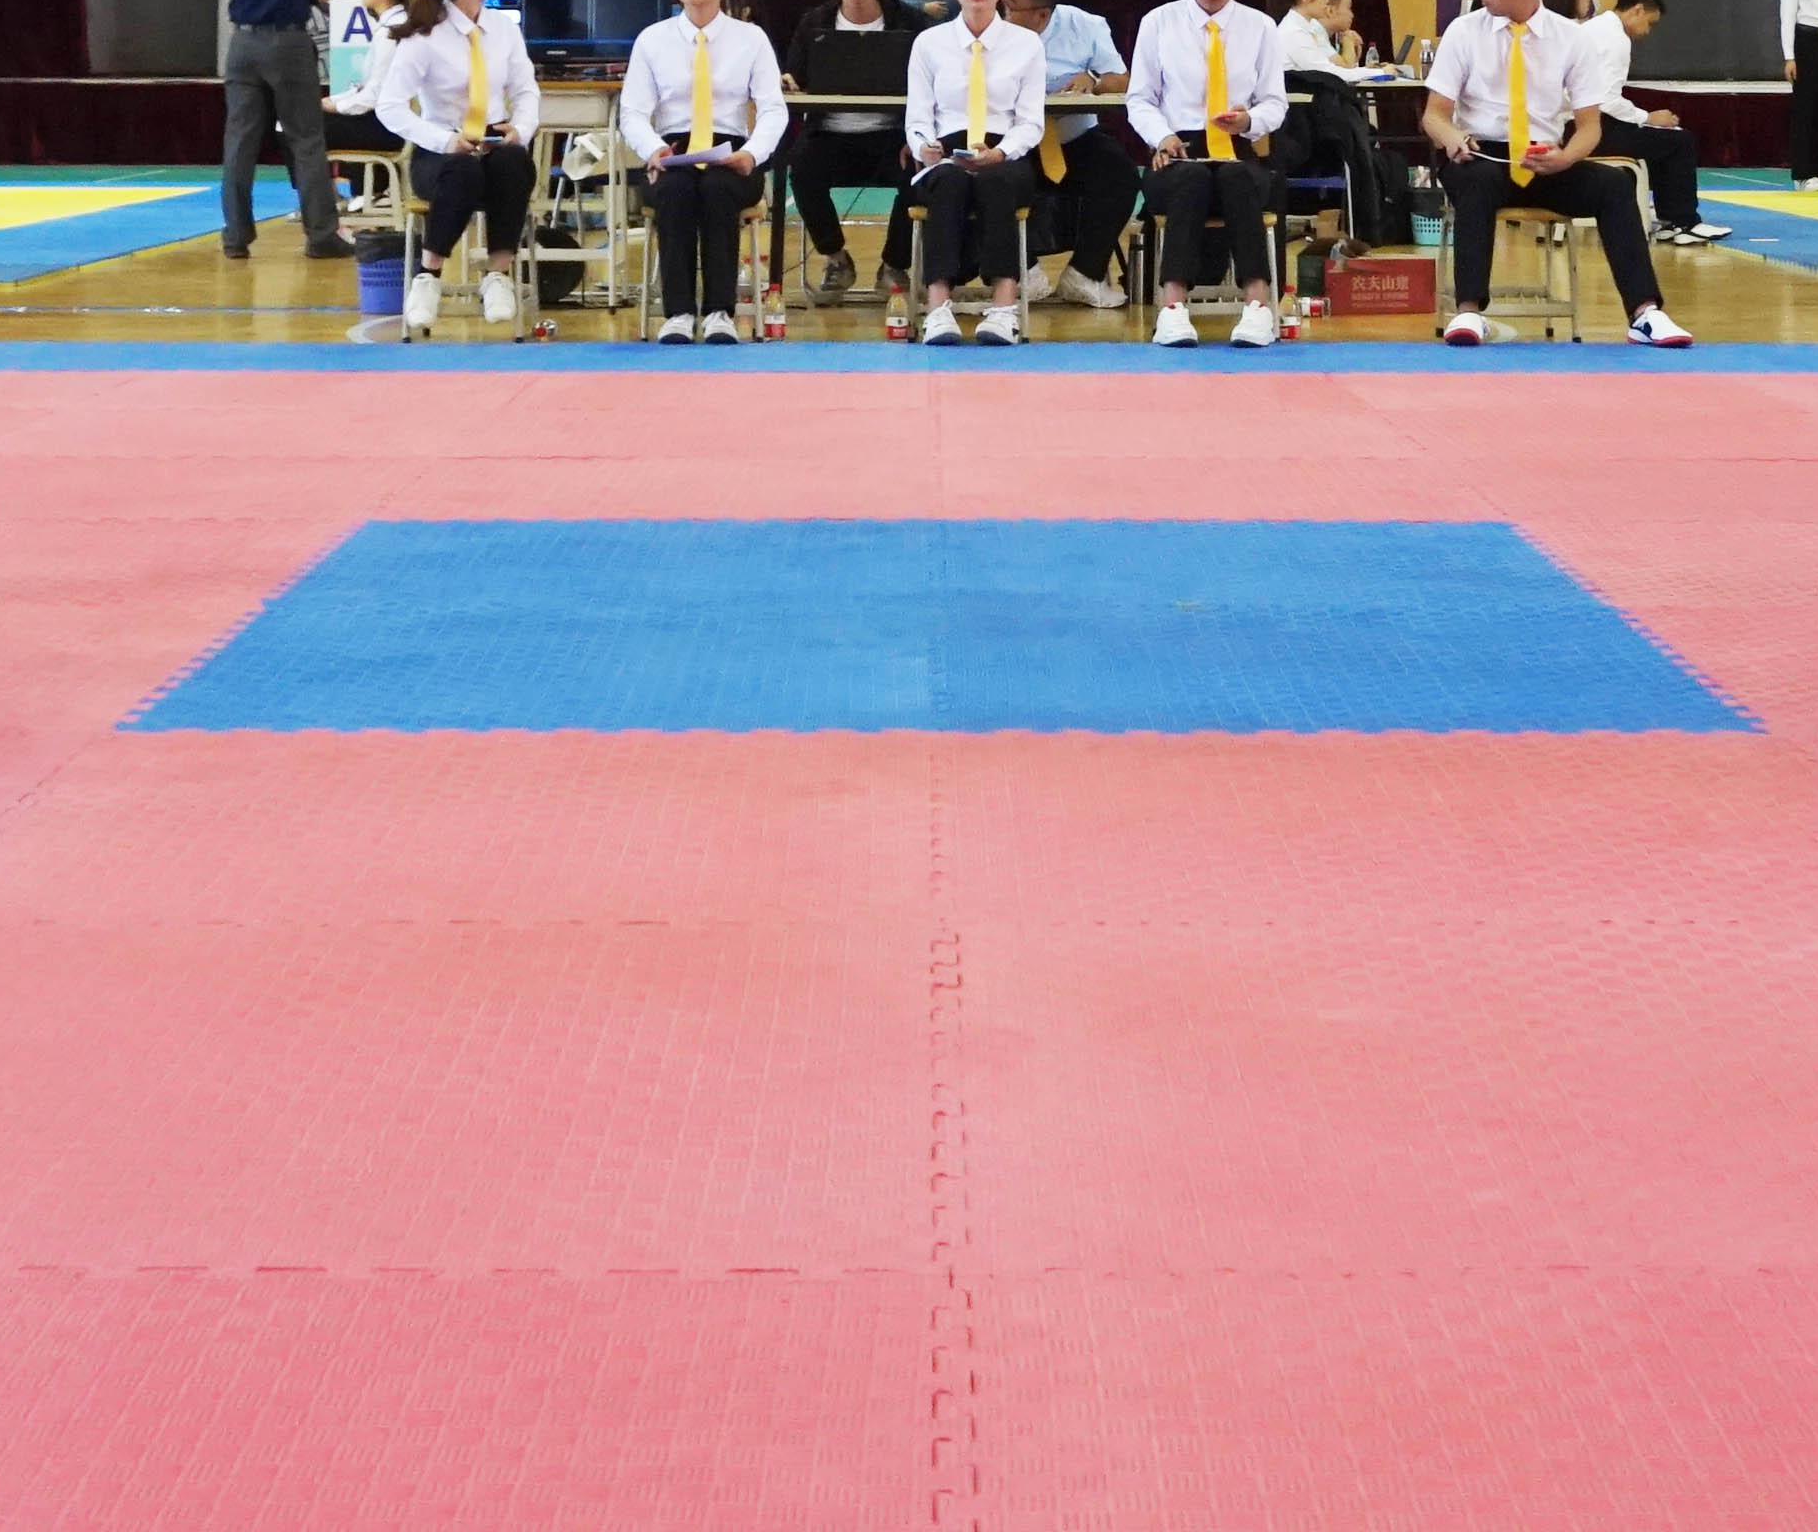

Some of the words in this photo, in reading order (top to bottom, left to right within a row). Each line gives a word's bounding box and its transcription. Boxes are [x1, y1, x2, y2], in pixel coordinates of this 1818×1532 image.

[342, 6, 373, 43] A
[1351, 275, 1410, 292] 农夫山泉
